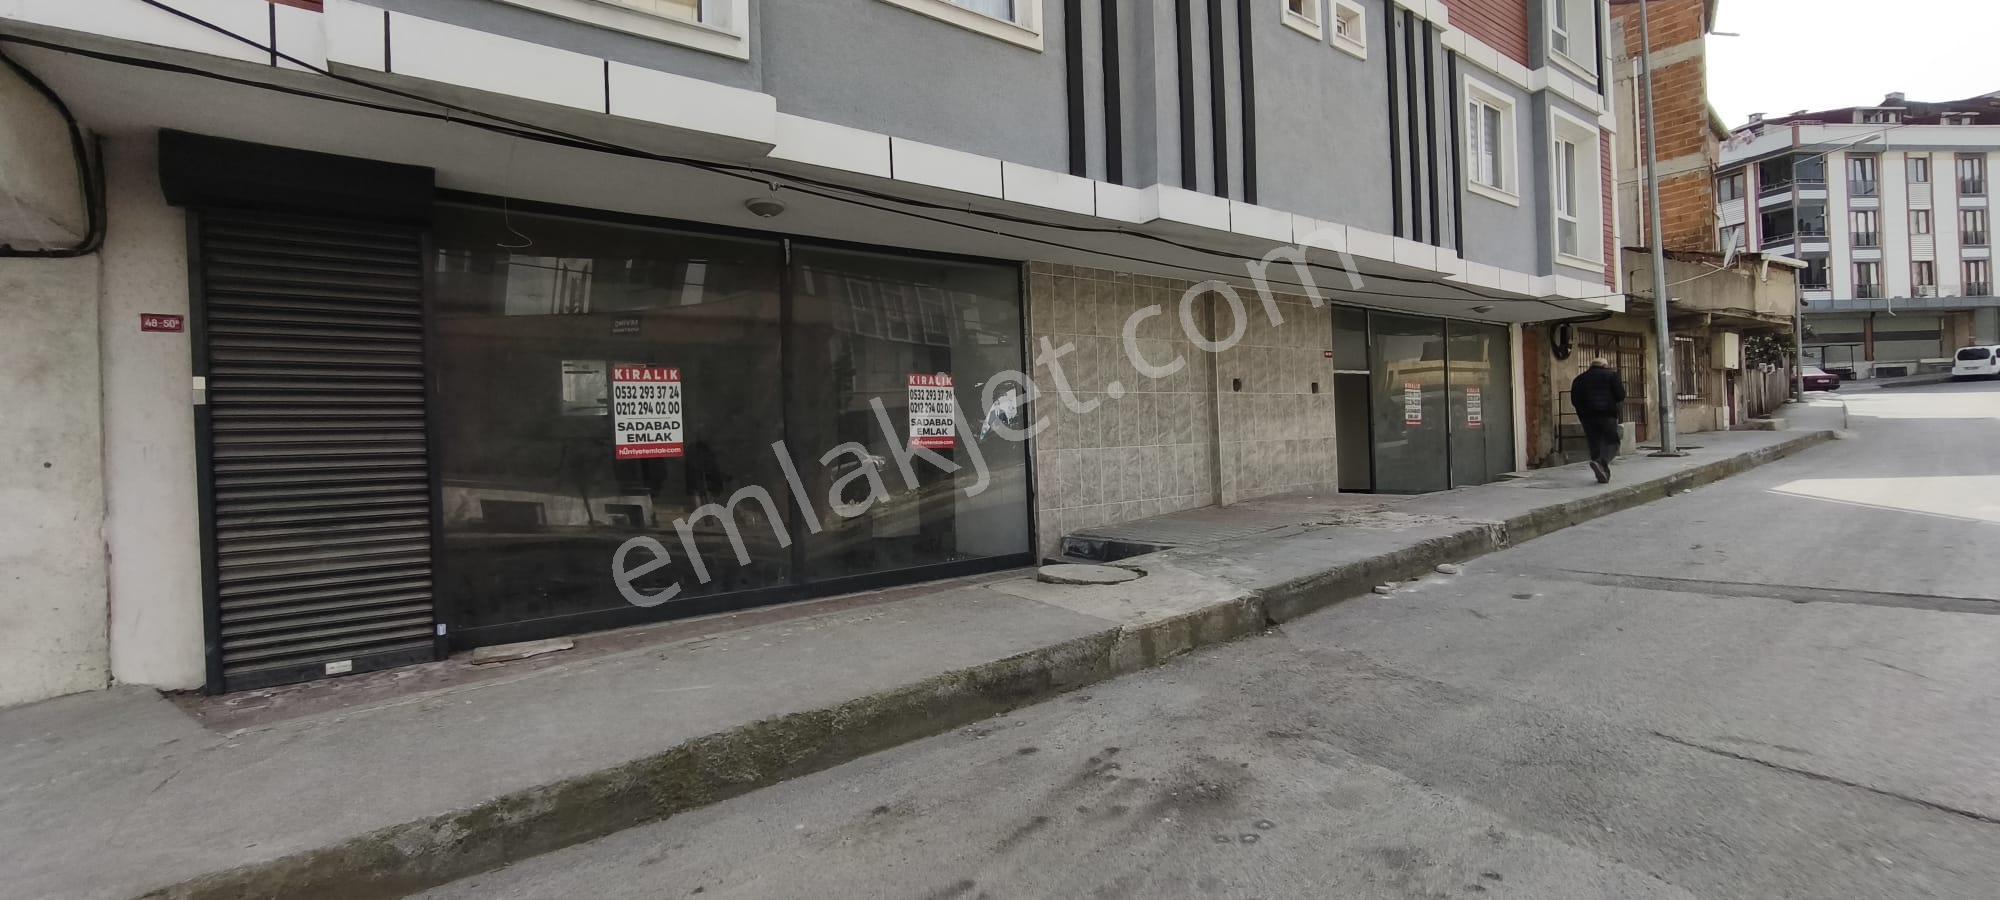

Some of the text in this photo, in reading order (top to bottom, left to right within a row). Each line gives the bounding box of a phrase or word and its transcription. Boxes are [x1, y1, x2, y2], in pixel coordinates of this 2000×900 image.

[615, 386, 679, 399] 0532 293 37 24
[910, 389, 925, 400] 0532
[925, 389, 936, 400] 293
[937, 389, 944, 400] 37
[616, 401, 680, 415] 0212 294 02 00
[936, 402, 944, 413] 02
[944, 402, 952, 413] 00
[617, 421, 680, 431] SADABAD
[911, 418, 953, 426] SADABAD
[627, 433, 672, 443] EMLAK
